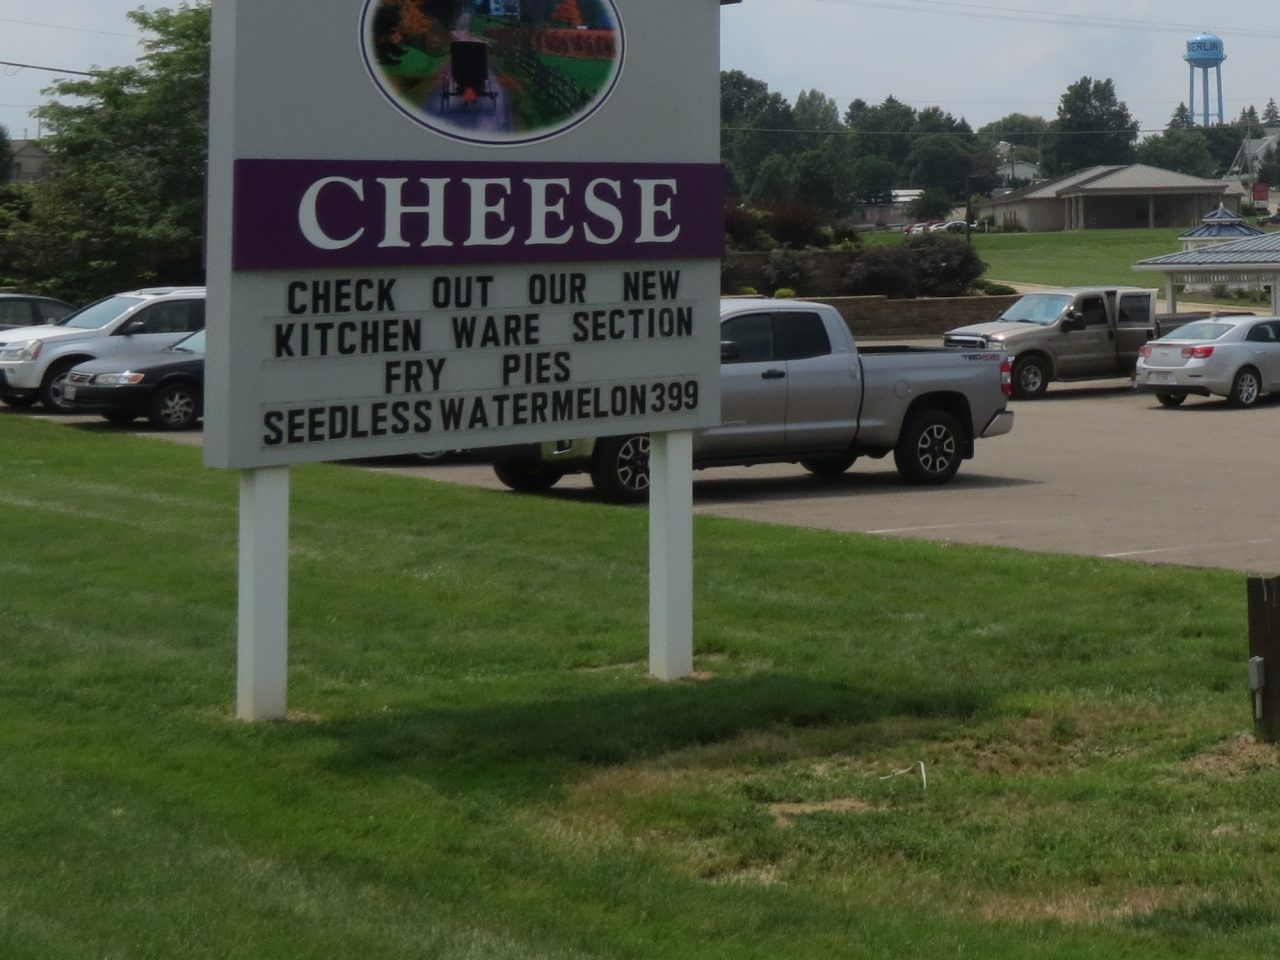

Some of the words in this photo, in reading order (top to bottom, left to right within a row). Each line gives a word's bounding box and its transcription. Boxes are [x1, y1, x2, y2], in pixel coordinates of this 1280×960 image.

[1187, 41, 1218, 52] BERLIN
[298, 176, 681, 250] CHEESE
[287, 277, 397, 316] CHECK
[432, 274, 495, 309] OUT
[528, 272, 587, 305] OUR
[623, 269, 681, 302] NEW
[275, 318, 422, 358] KITCHEN
[451, 312, 540, 349] WARE
[572, 306, 693, 343] SECTION
[384, 357, 447, 395] FRY
[502, 351, 571, 387] PIES
[263, 399, 433, 446] SEEDLESS
[439, 384, 647, 431] WATERMELON
[650, 379, 699, 413] 399
